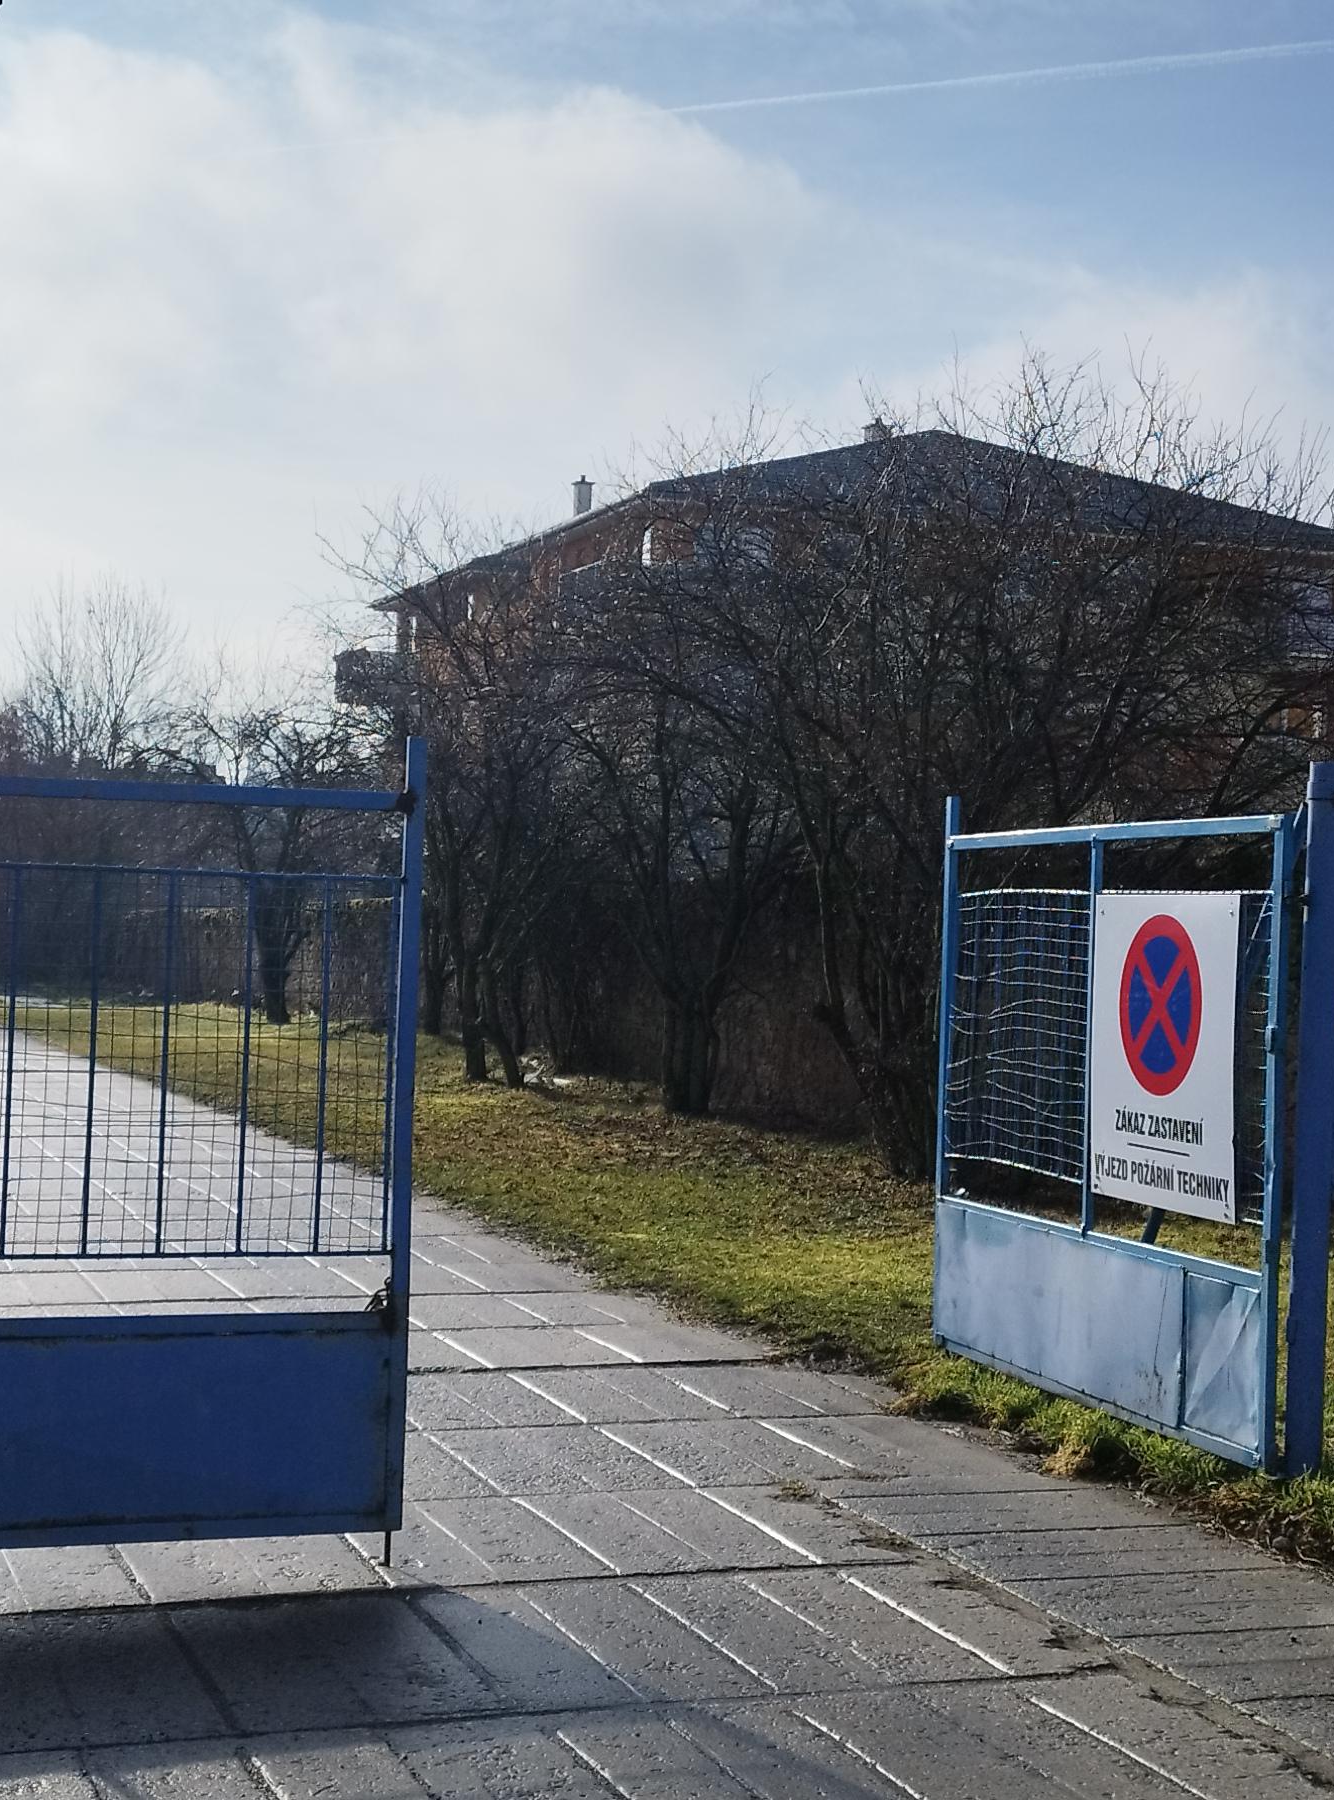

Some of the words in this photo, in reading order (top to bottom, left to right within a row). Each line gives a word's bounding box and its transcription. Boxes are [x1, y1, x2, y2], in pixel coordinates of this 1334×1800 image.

[1115, 1105, 1146, 1135] ZÁKAZ
[1148, 1114, 1203, 1146] ZASTAVENÍ
[1094, 1149, 1128, 1181] VÝJEZD
[1131, 1159, 1175, 1191] POŽÁRNÍ
[1177, 1169, 1229, 1203] TECHNIKY
